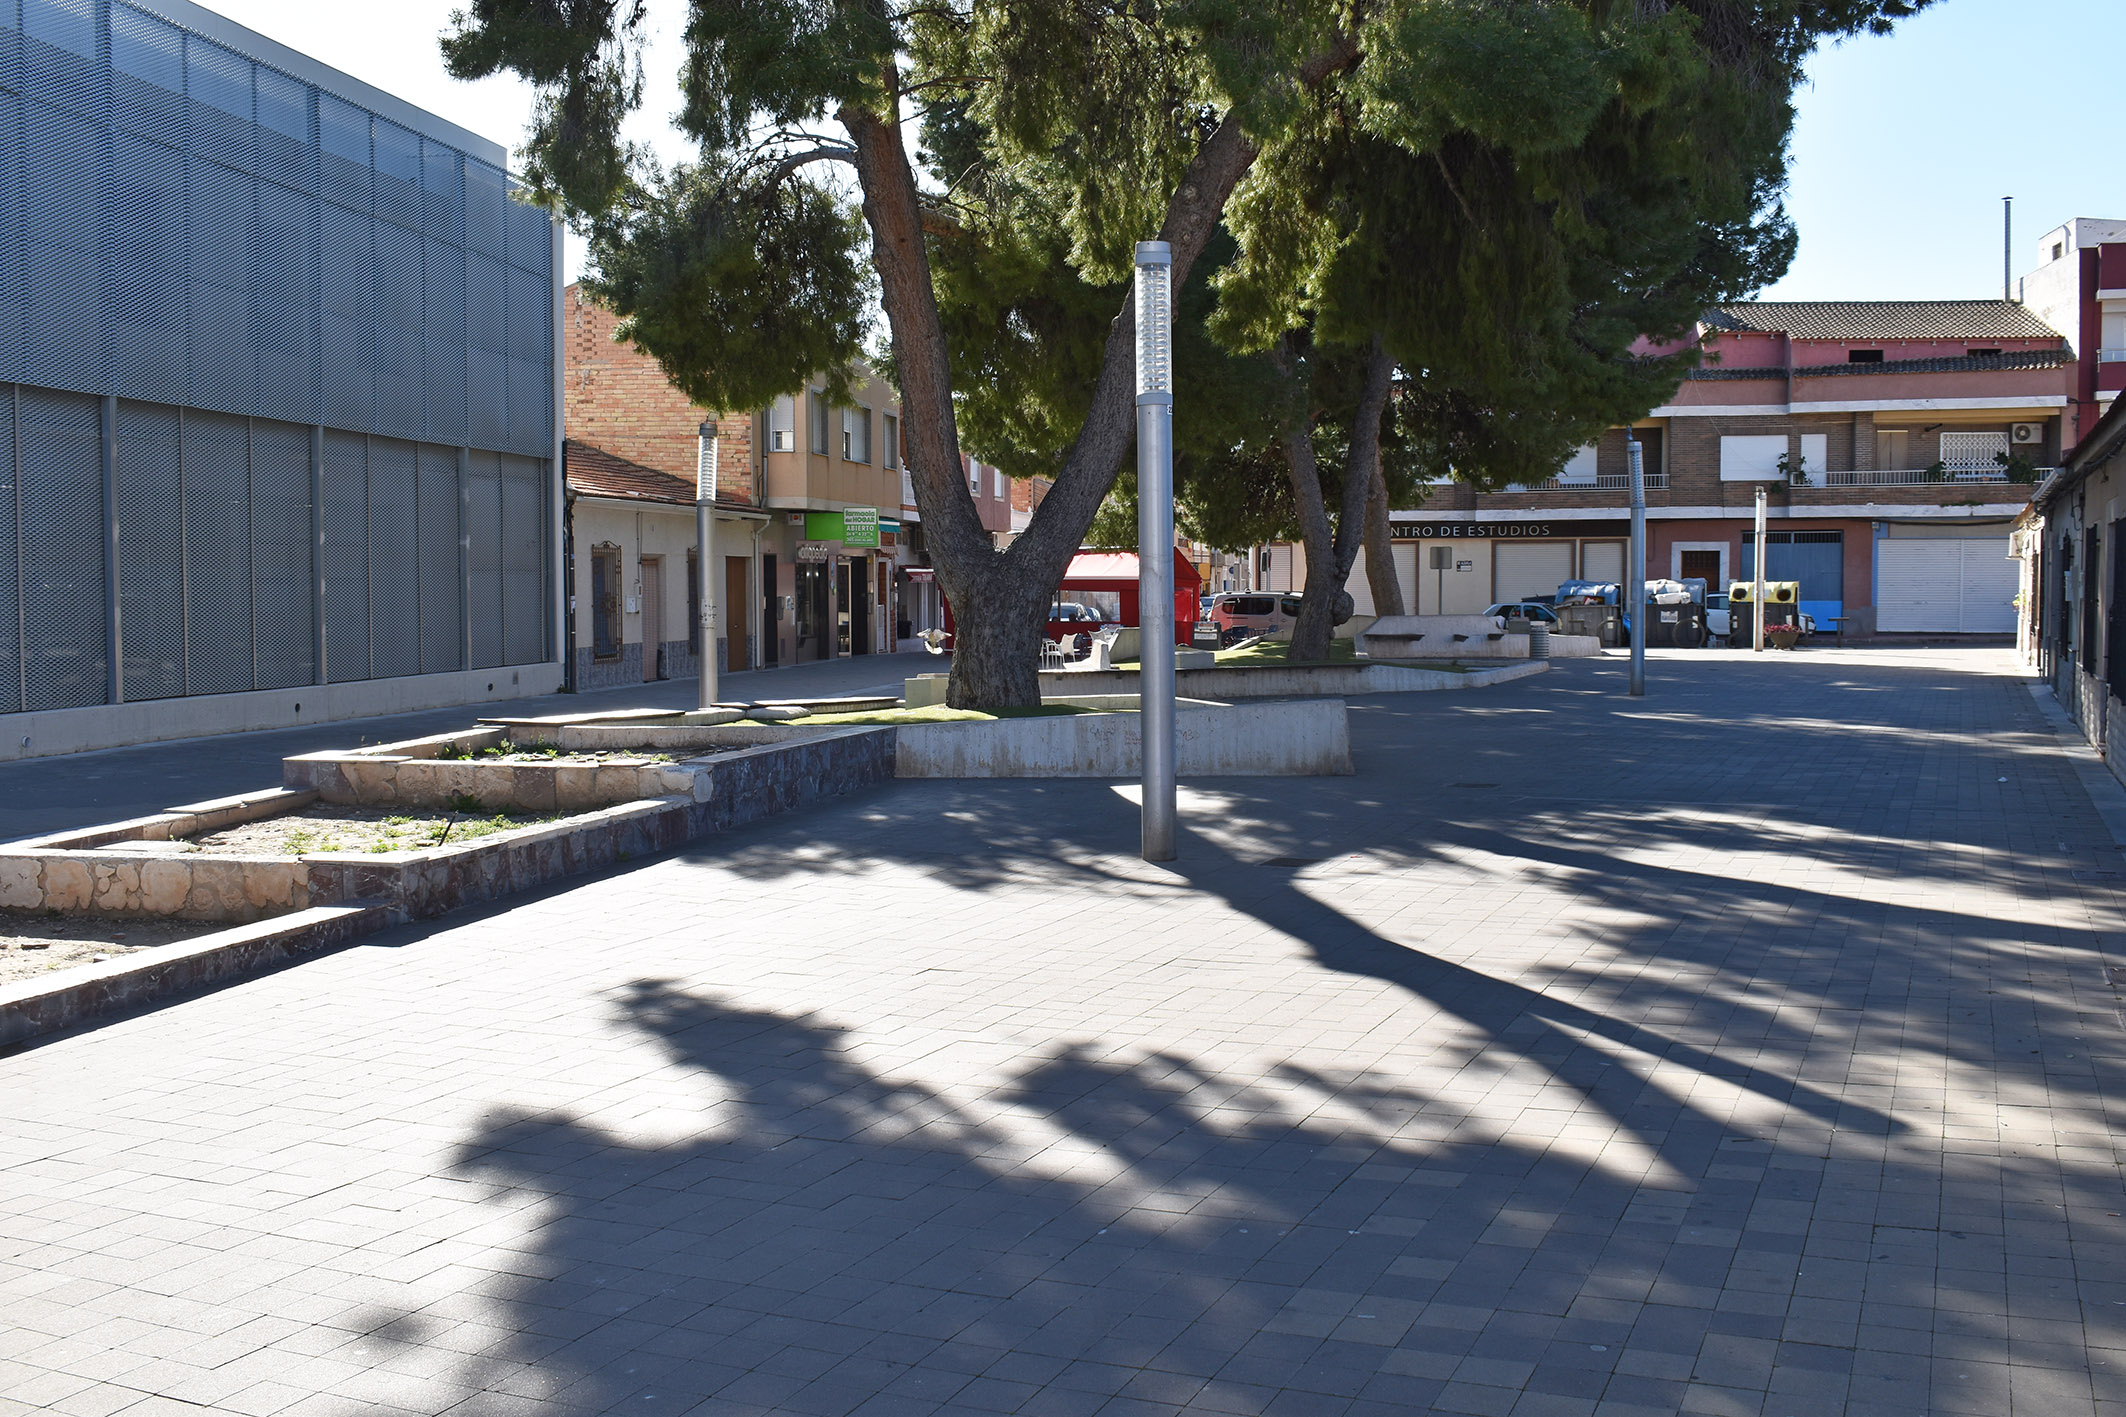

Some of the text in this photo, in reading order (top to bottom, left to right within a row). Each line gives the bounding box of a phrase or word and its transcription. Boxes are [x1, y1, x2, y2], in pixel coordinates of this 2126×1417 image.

[1390, 524, 1550, 537] NTRO DE ESTUDIOS
